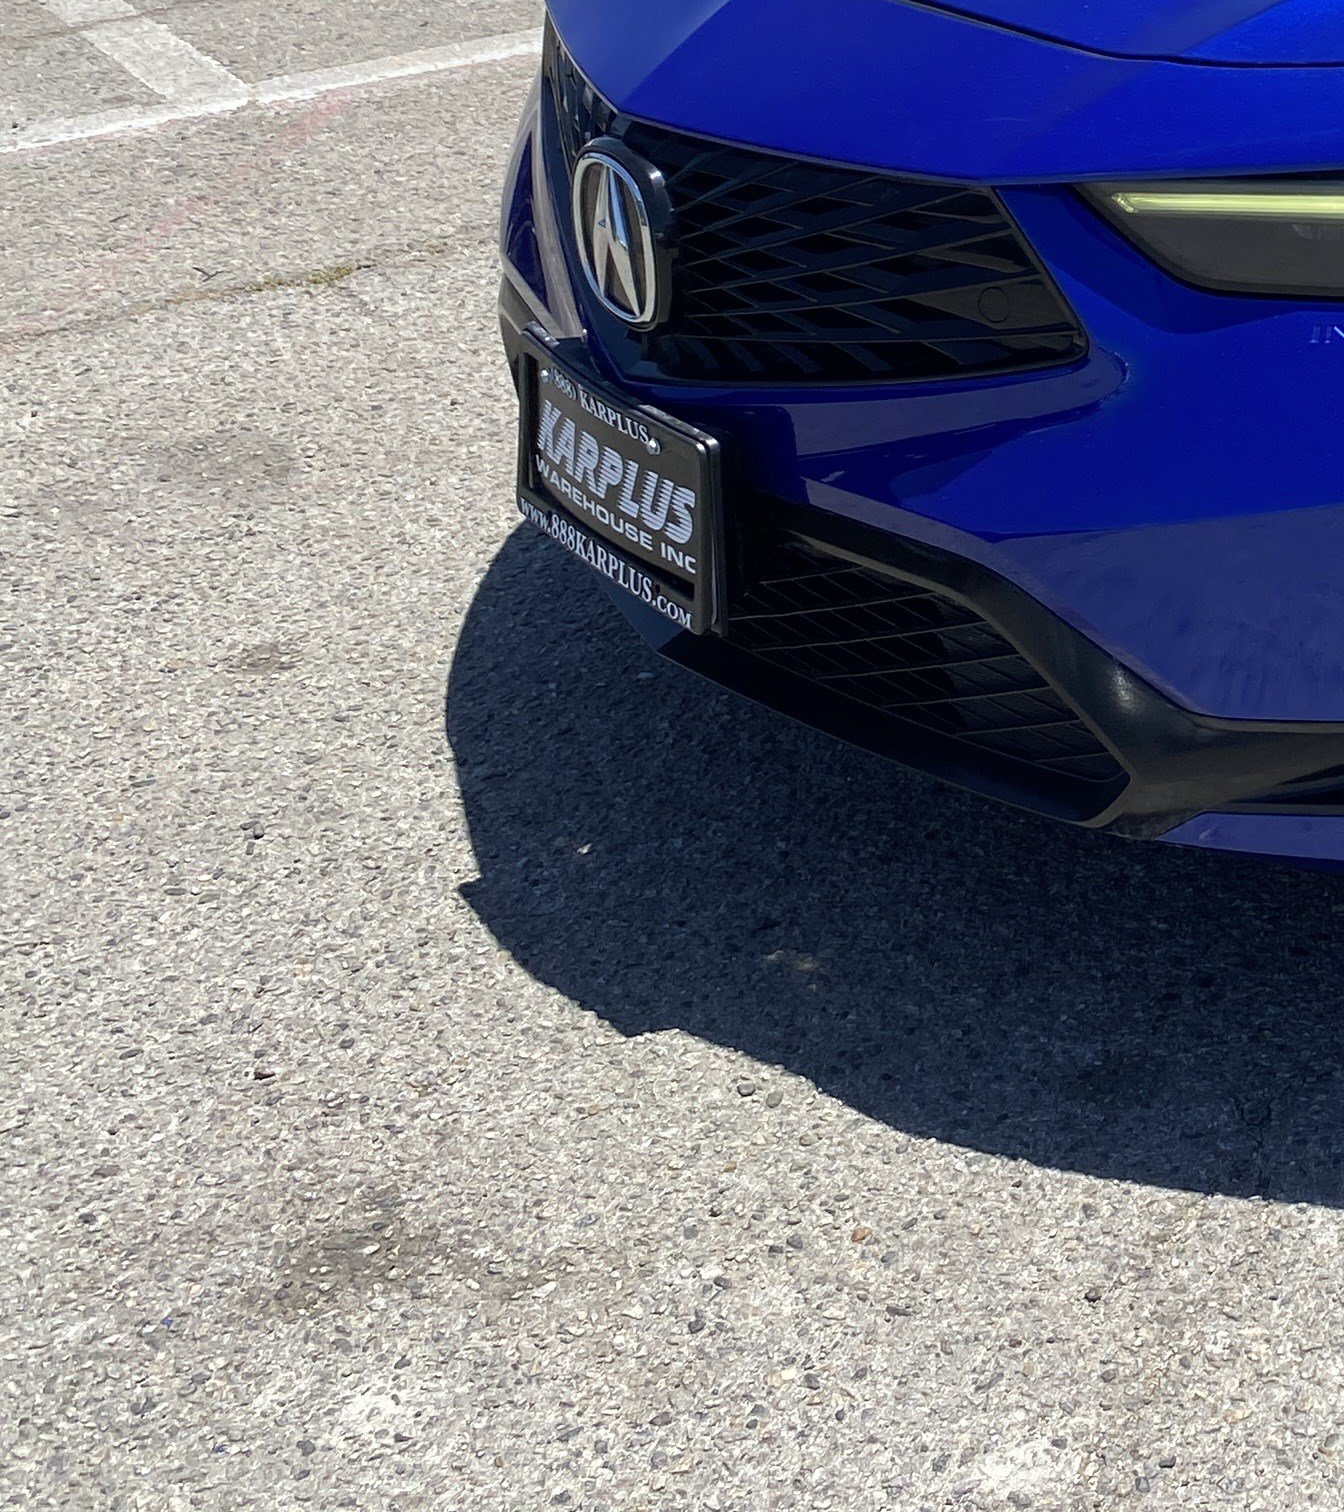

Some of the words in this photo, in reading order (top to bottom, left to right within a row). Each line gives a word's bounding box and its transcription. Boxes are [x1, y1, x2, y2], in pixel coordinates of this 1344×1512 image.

[537, 399, 696, 544] KARPLUS
[579, 389, 649, 444] KARPLUS
[535, 454, 653, 551] WAREHOUSE
[660, 541, 697, 574] INC
